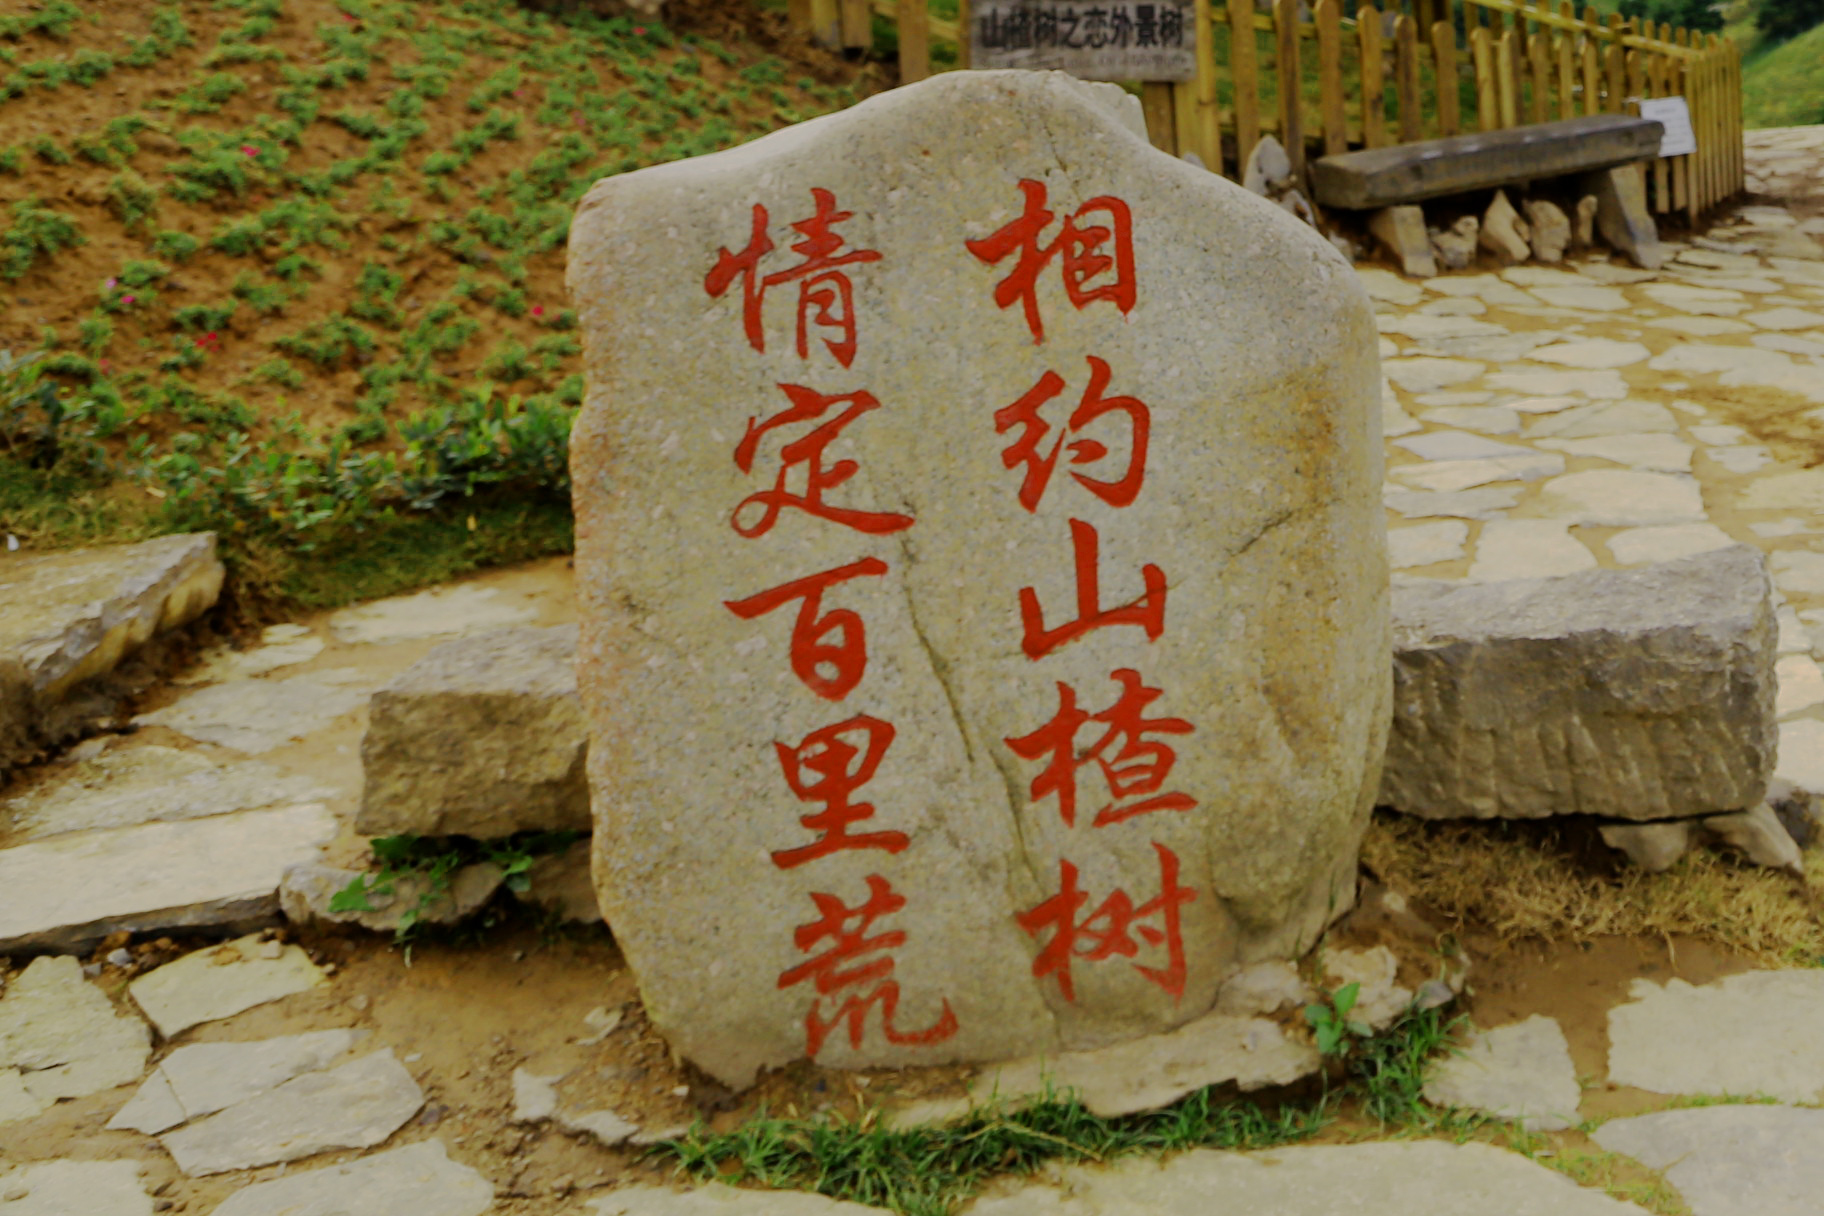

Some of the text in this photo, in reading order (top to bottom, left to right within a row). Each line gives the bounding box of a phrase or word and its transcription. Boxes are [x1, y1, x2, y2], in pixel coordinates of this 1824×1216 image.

[705, 186, 959, 1060] 情定百里荒
[966, 177, 1198, 1002] 相约山楂树
